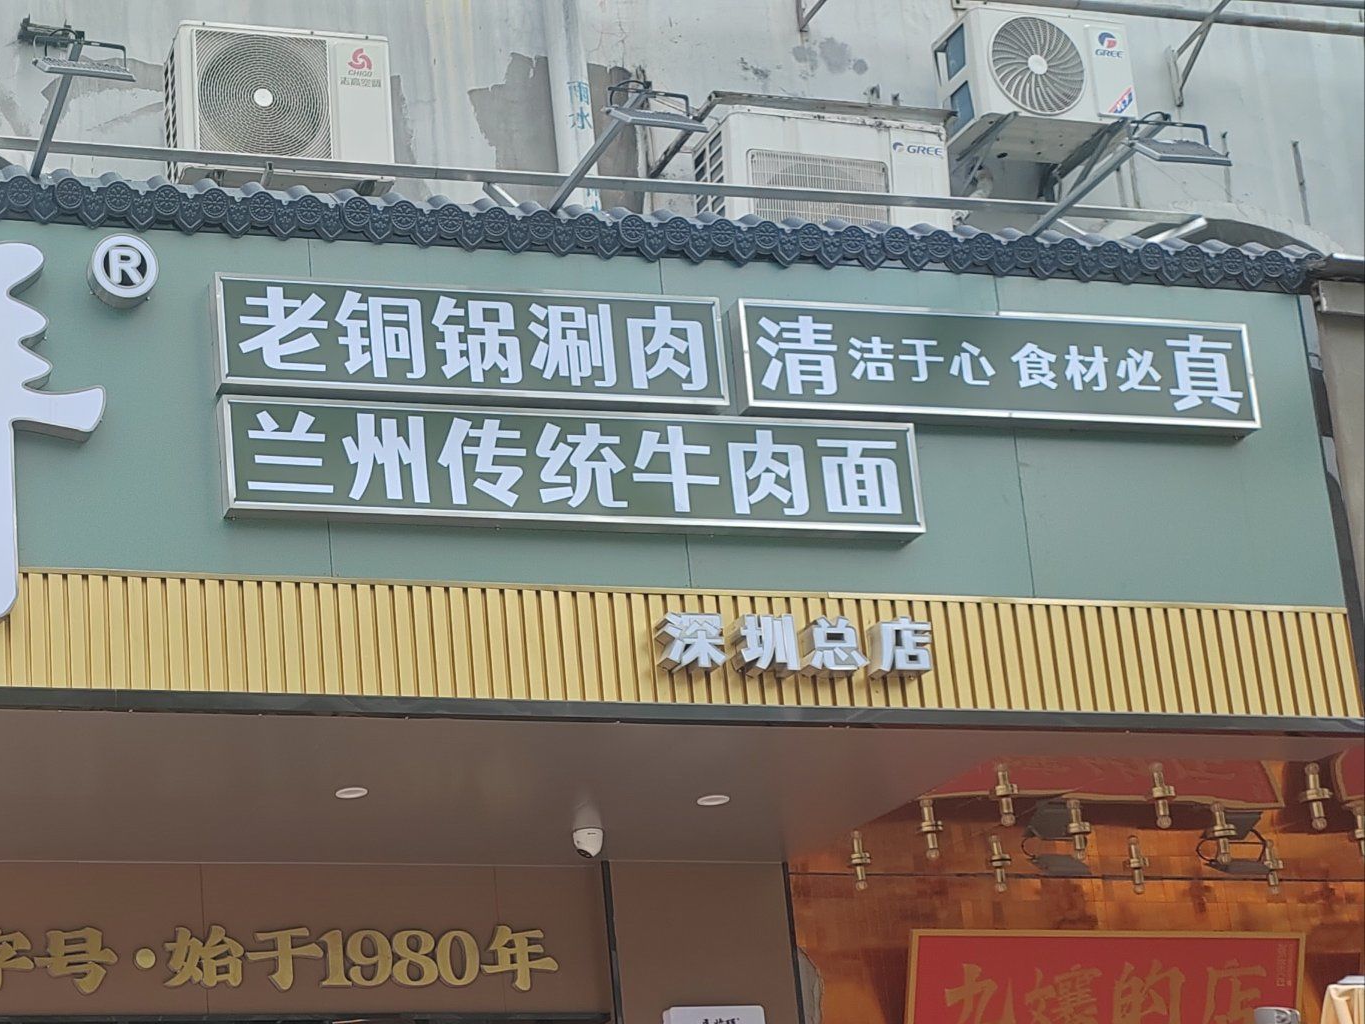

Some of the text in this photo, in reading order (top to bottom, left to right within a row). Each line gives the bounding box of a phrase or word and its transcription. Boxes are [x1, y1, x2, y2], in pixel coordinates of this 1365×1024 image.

[1095, 48, 1124, 58] GREE
[566, 79, 594, 130] 雨水
[906, 144, 943, 157] GREE
[238, 285, 709, 392] 老铜锅涮肉
[755, 314, 1244, 414] 清洁于心 食材必真
[247, 410, 903, 516] 兰州传统牛肉面
[658, 611, 933, 679] 深圳总店
